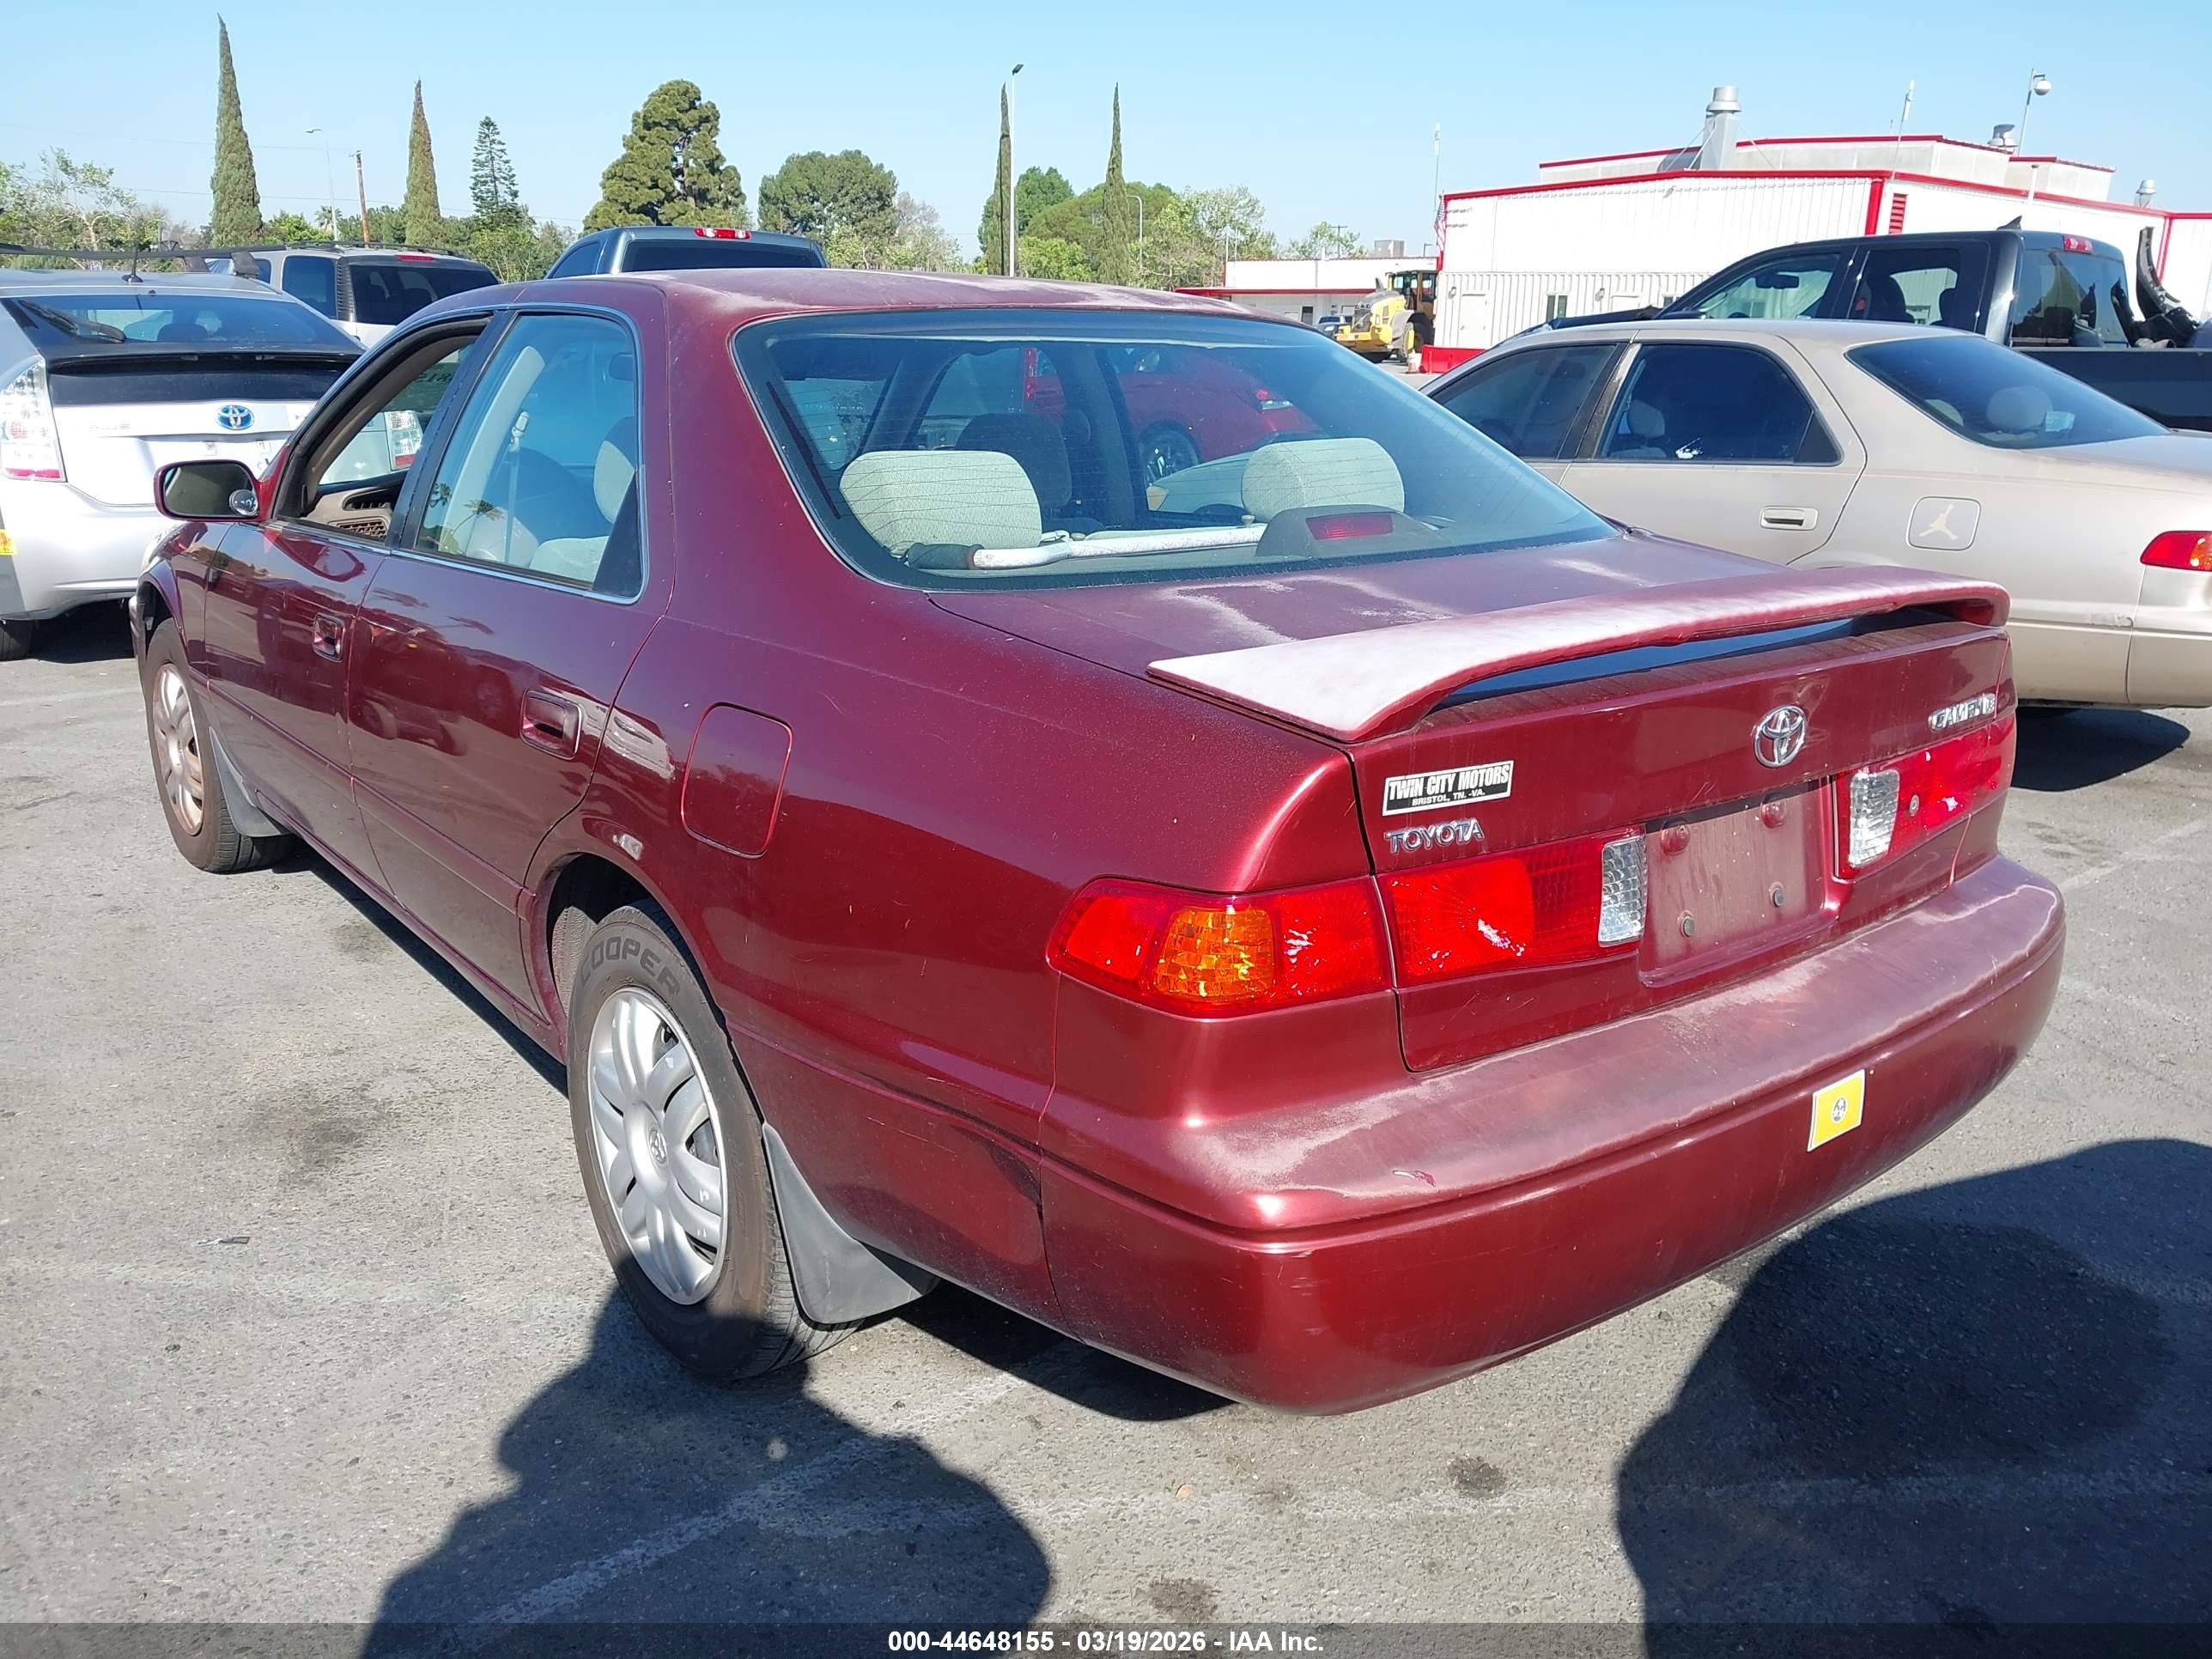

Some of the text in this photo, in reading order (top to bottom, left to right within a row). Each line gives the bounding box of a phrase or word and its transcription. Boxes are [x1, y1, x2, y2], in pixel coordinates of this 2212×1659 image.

[1389, 765, 1509, 800] TWIN CITY MOTORS
[1412, 793, 1450, 806] BRISTOL,
[1386, 818, 1484, 854] TOYOTA
[580, 936, 680, 995] COOPER
